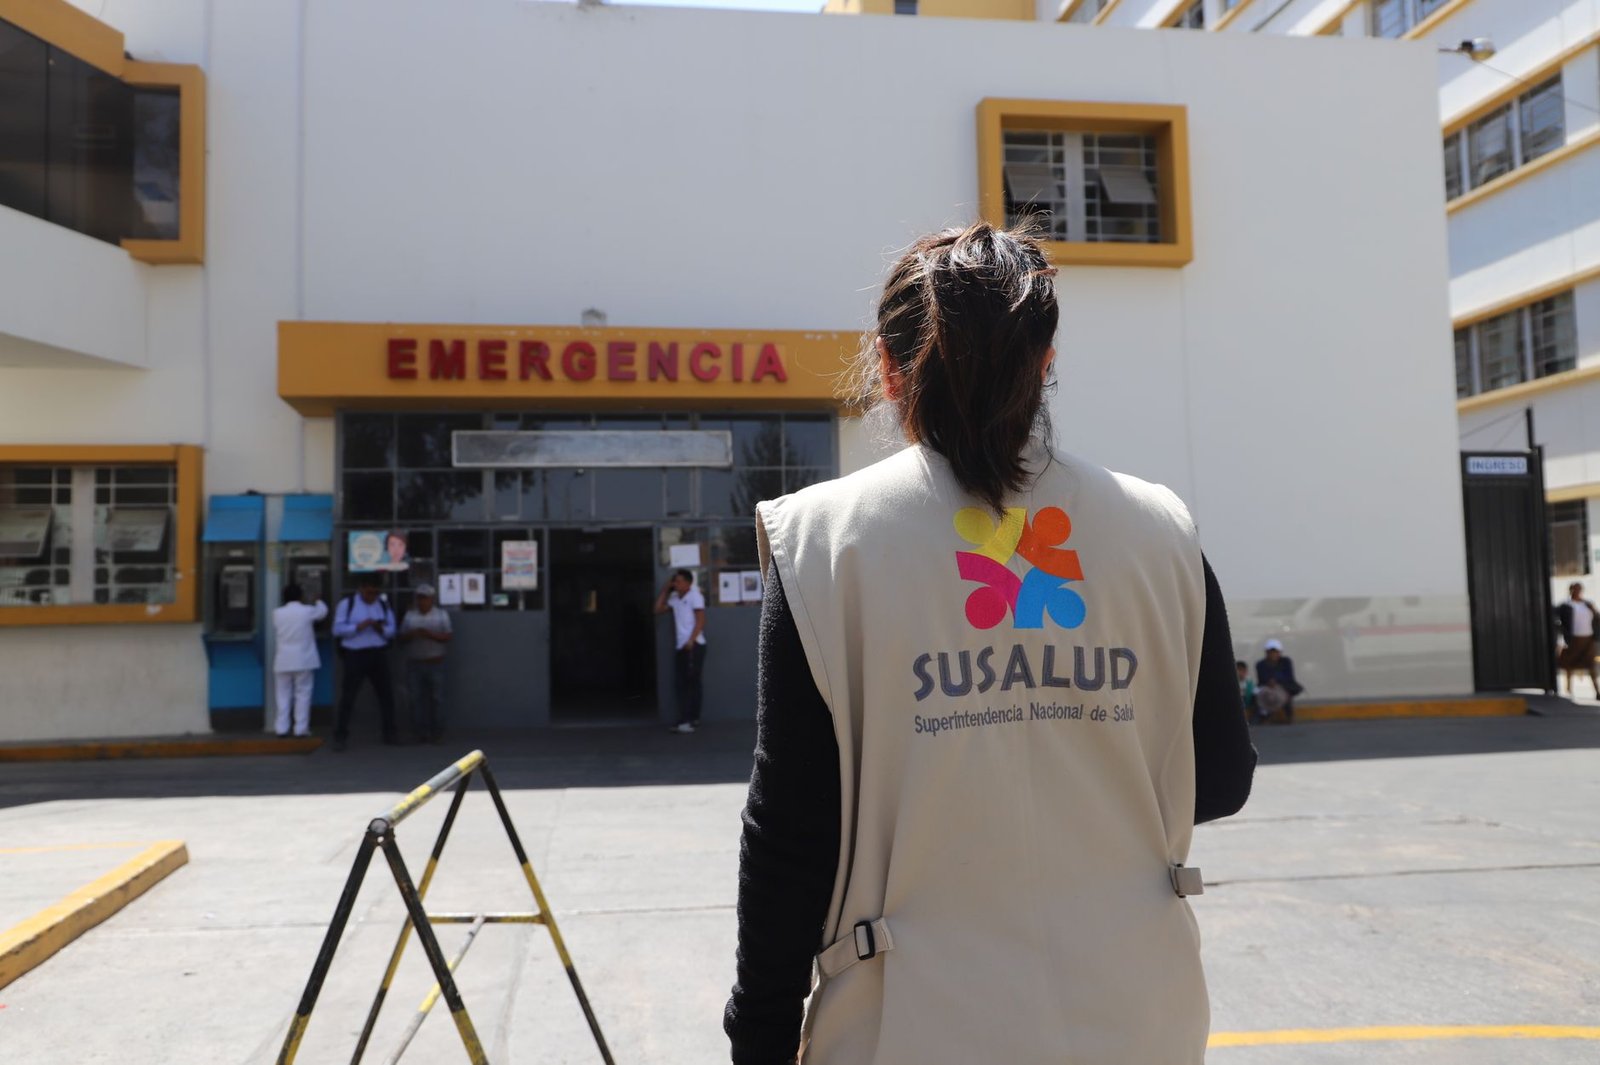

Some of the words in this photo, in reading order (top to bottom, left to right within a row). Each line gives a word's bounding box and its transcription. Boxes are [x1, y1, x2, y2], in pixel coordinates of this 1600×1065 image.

[387, 338, 788, 382] EMERGENCIA
[1471, 460, 1525, 471] INGRESO
[912, 644, 1138, 701] SUSALUD
[914, 704, 1024, 736] Superintendencia
[1030, 702, 1083, 720] Nacional
[1090, 704, 1107, 722] de
